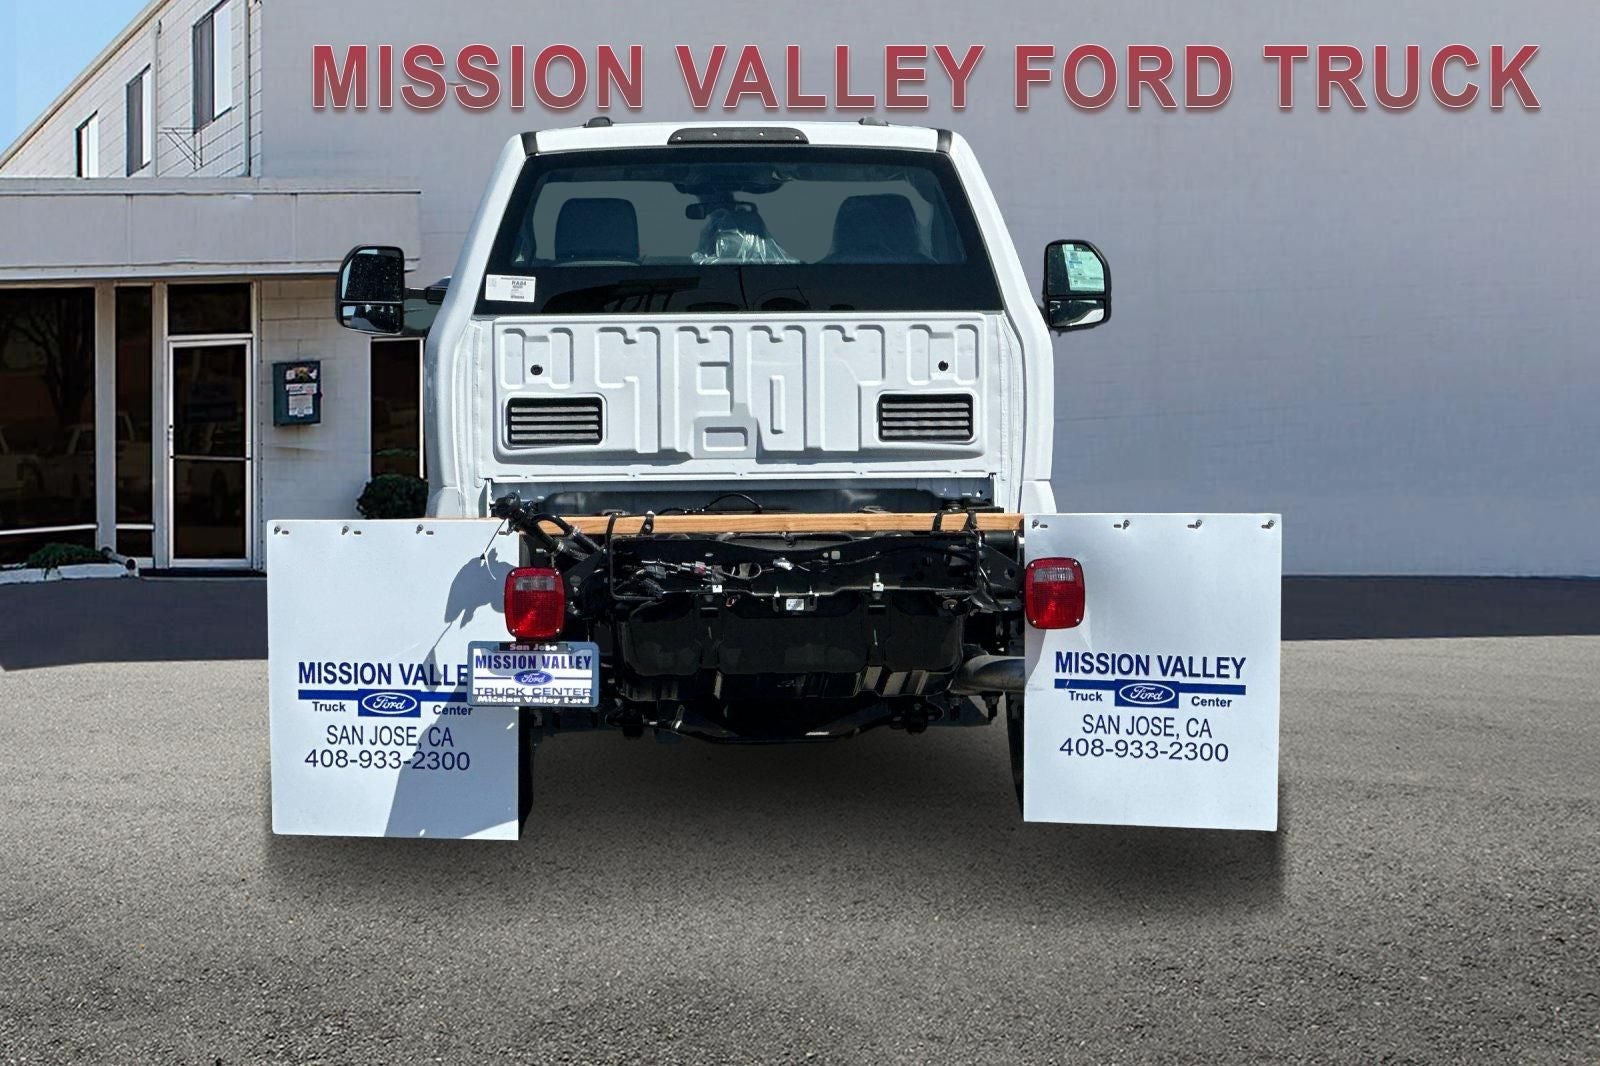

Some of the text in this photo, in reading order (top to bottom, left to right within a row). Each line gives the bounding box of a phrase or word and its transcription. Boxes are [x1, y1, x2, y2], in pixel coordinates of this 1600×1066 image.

[311, 43, 1541, 110] MISSION VALLEY FORD TRUCK
[298, 661, 468, 687] MISSION VALLE
[475, 655, 592, 670] MISSION VALLEY
[1055, 651, 1246, 679] MISSION VALLEY
[521, 673, 545, 683] Ford
[474, 687, 591, 696] TRUCK CENTER
[524, 696, 561, 705] Valley
[1068, 686, 1233, 708] Truck Ford Center
[312, 695, 473, 716] Truck Ford Center
[326, 724, 454, 750] SAN JOSE, CA
[1082, 713, 1213, 740] SAN JOSE, CA
[304, 748, 471, 771] 408-933-2300
[1059, 737, 1229, 762] 408-933-2300
